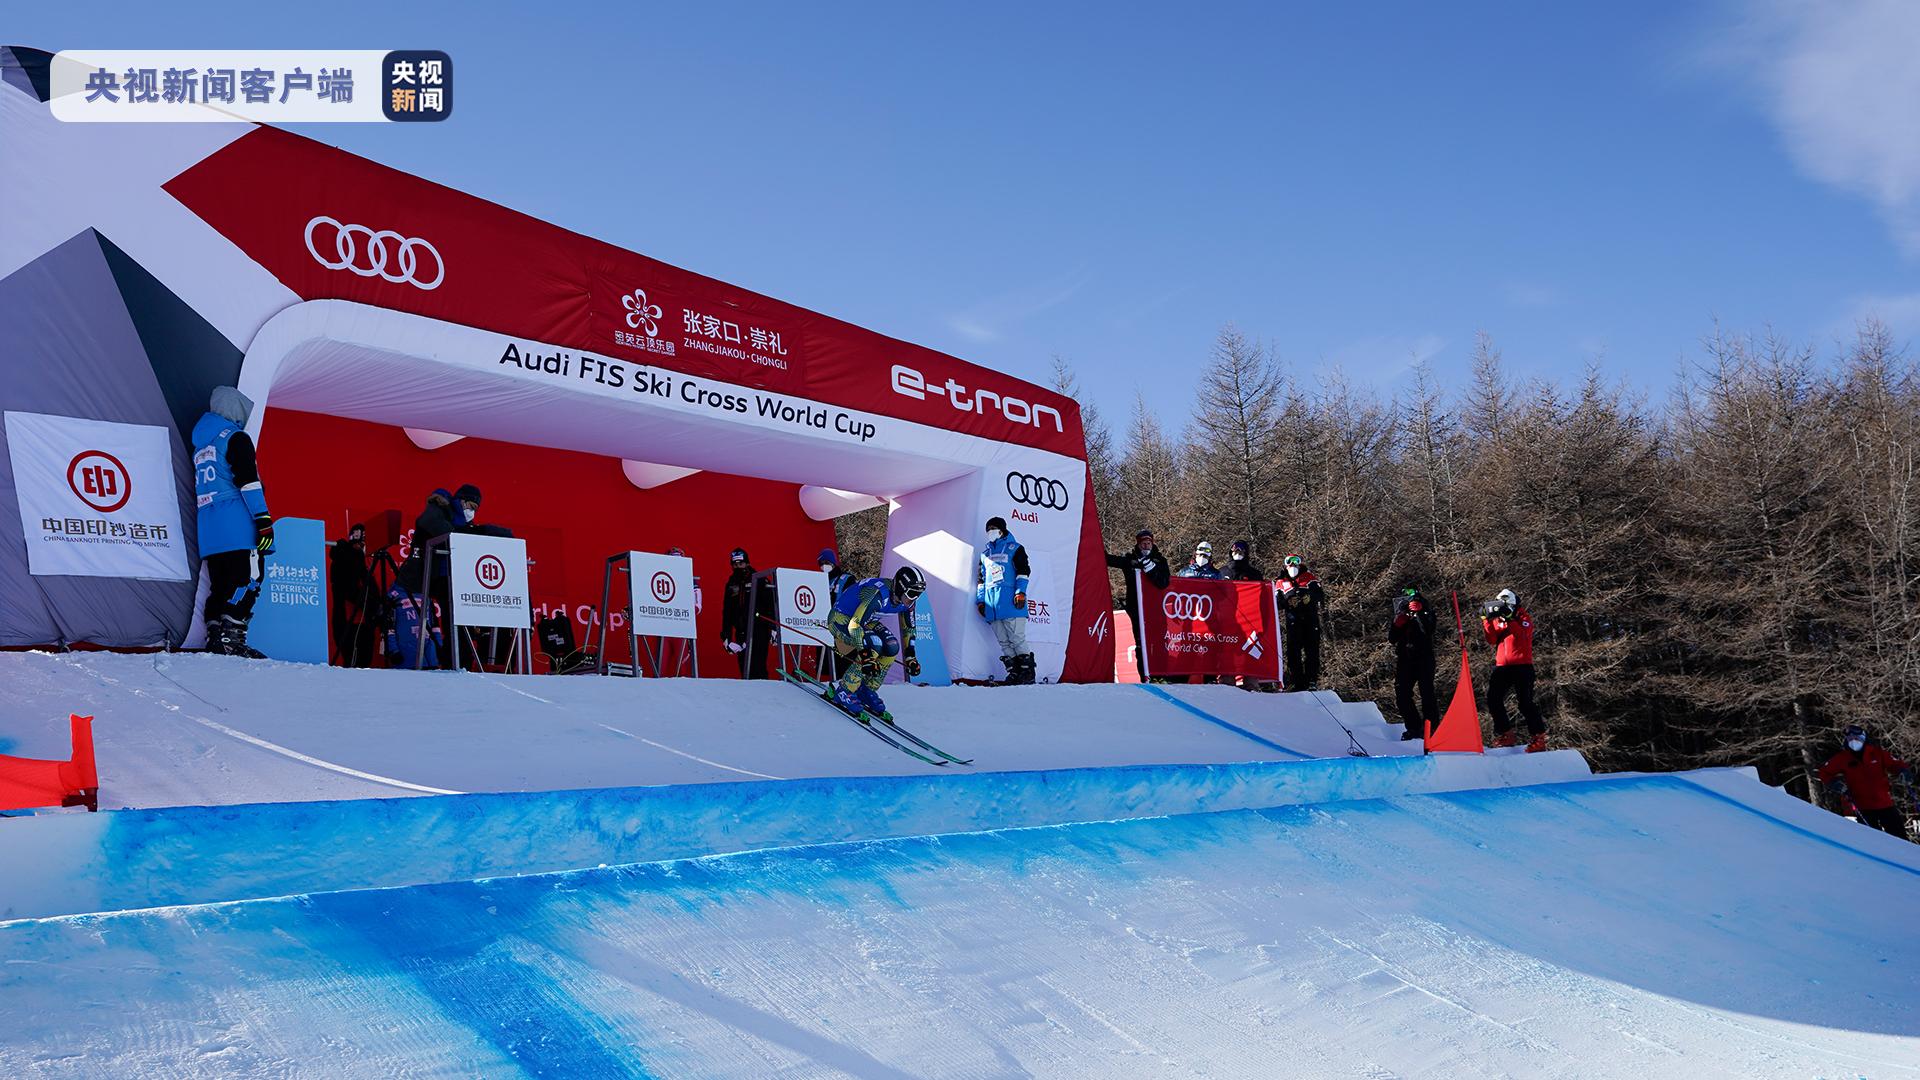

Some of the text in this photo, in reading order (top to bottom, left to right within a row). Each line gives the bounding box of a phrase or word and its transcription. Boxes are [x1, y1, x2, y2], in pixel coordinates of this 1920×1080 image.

[683, 308, 788, 356] 张家口·崇礼
[499, 343, 876, 442] Audi FIS Ski Cross World Cup
[891, 364, 1063, 433] e-tron
[1011, 509, 1038, 524] Audi
[42, 518, 168, 540] 中国印钞造币
[101, 538, 131, 546] PRINTING
[270, 584, 319, 594] EXPERIENCE
[271, 592, 319, 606] BEIJING
[460, 593, 522, 606] 中国印钞造币
[1164, 630, 1185, 641] Audi
[1187, 632, 1202, 641] FIS
[1217, 633, 1239, 644] Cross
[1164, 642, 1192, 652] World
